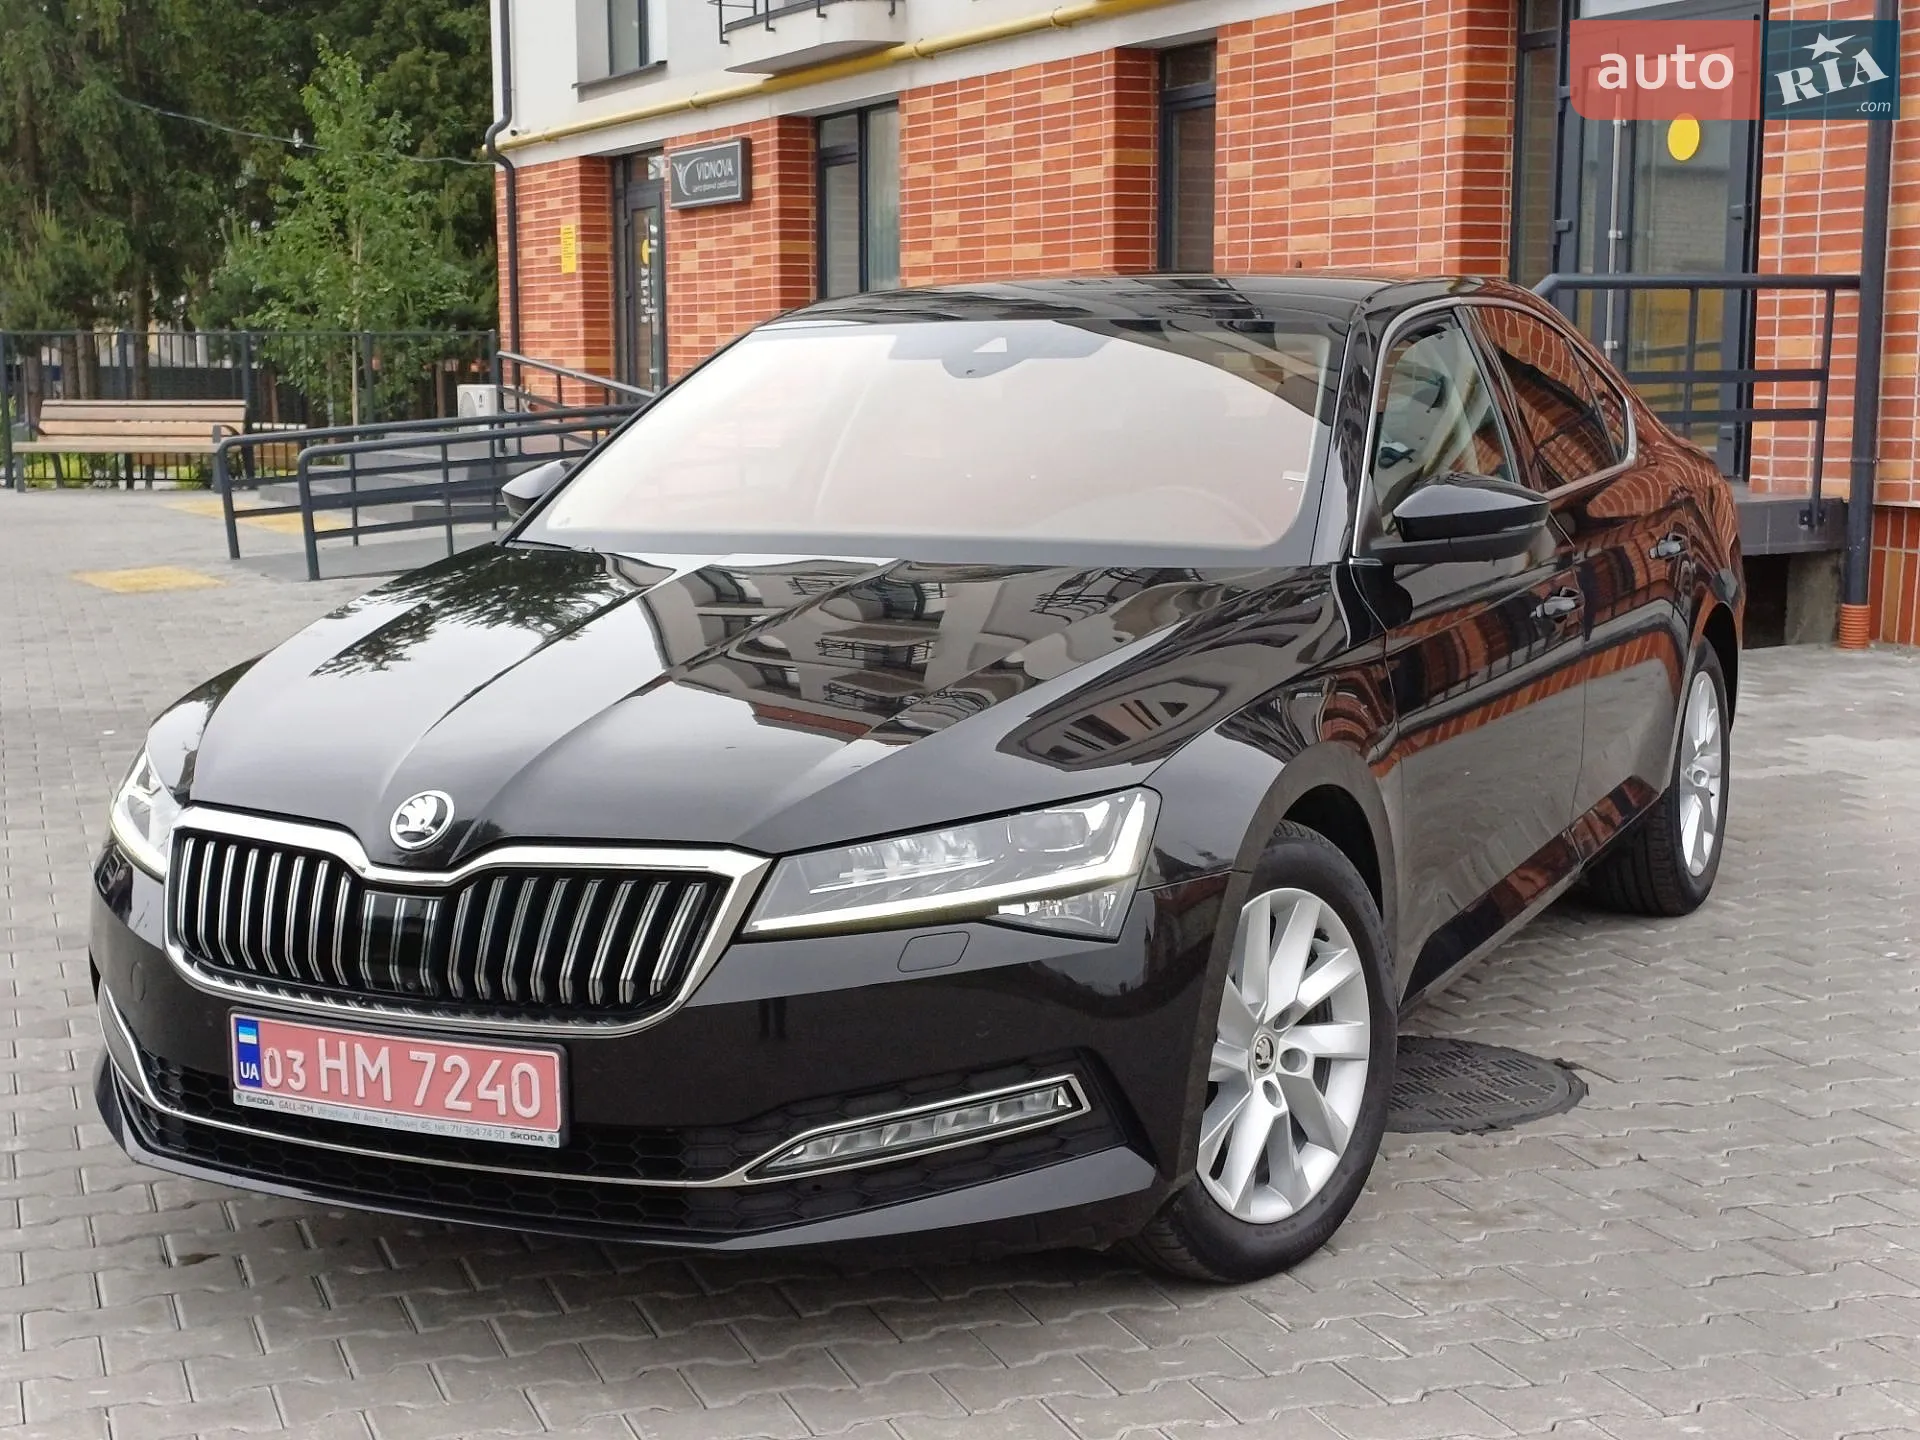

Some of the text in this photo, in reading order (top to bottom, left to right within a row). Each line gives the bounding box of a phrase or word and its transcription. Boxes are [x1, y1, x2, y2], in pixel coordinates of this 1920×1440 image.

[696, 158, 734, 181] VIDNOVA
[240, 1061, 260, 1081] UA
[263, 1038, 541, 1119] 03 HM 7240
